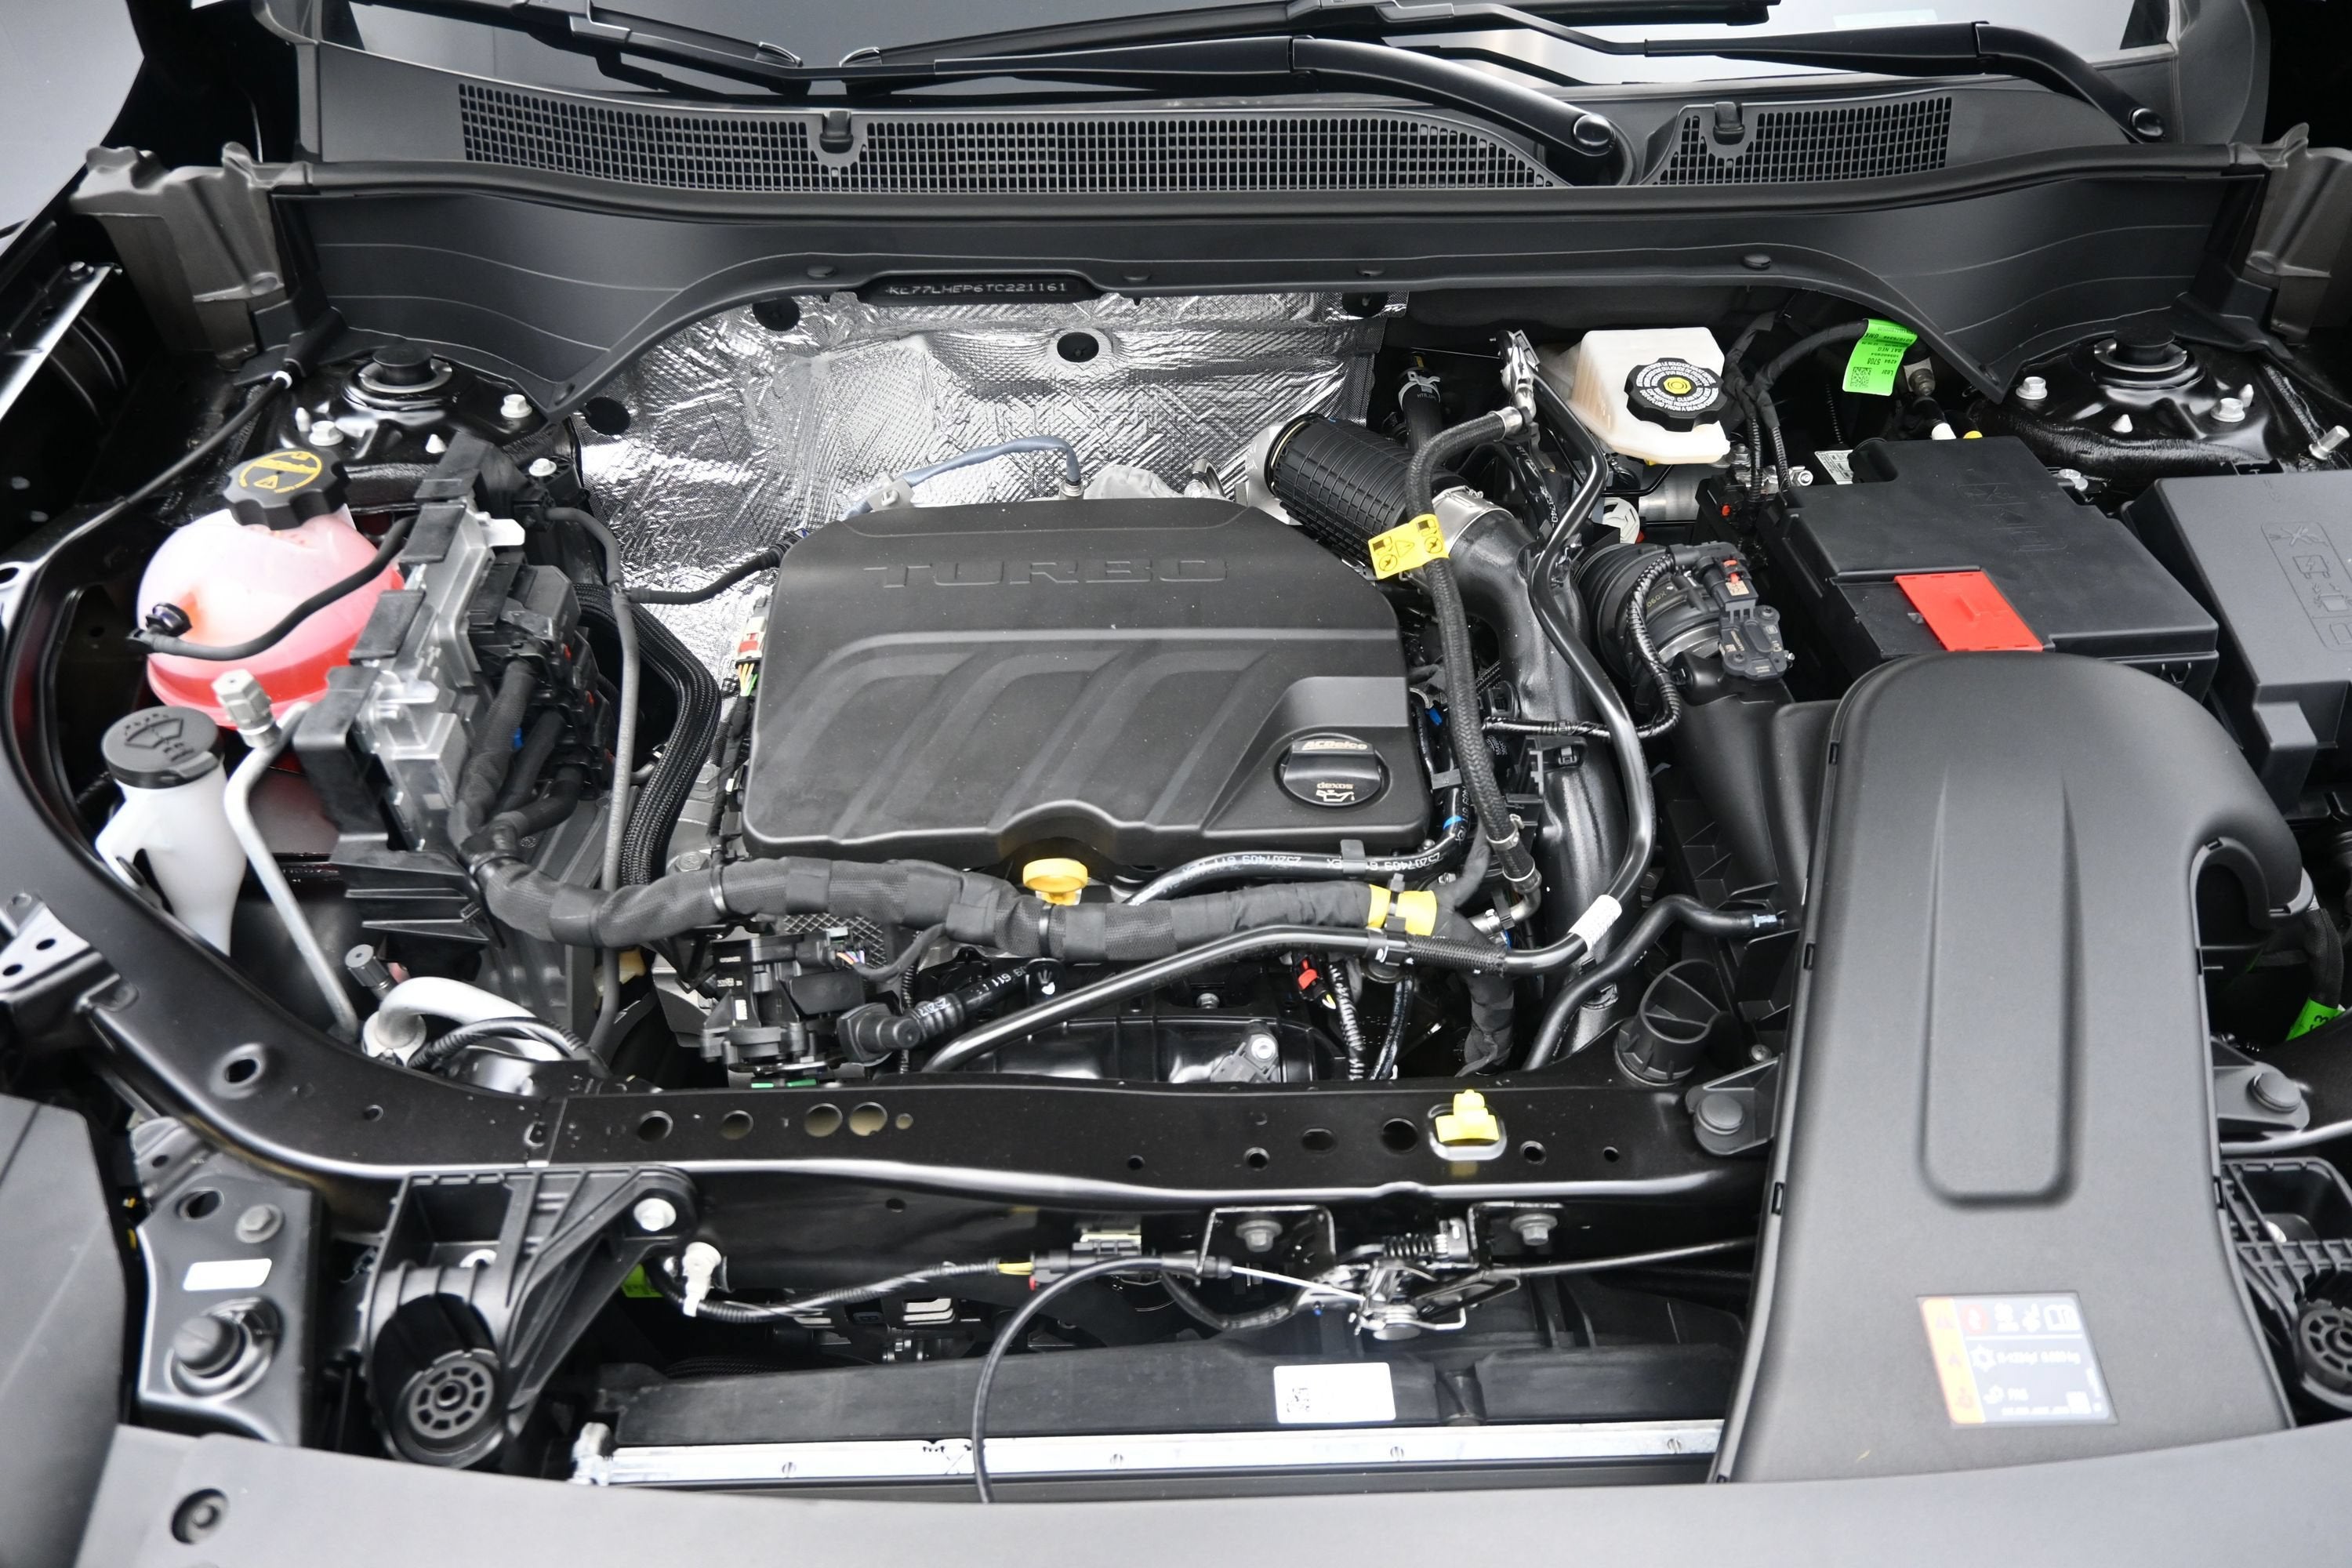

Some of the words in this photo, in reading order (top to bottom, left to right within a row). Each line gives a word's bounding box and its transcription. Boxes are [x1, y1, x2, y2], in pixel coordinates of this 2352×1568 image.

[862, 560, 1228, 588] TURBO
[1301, 739, 1368, 751] ACDelco
[1316, 781, 1355, 790] dexos
